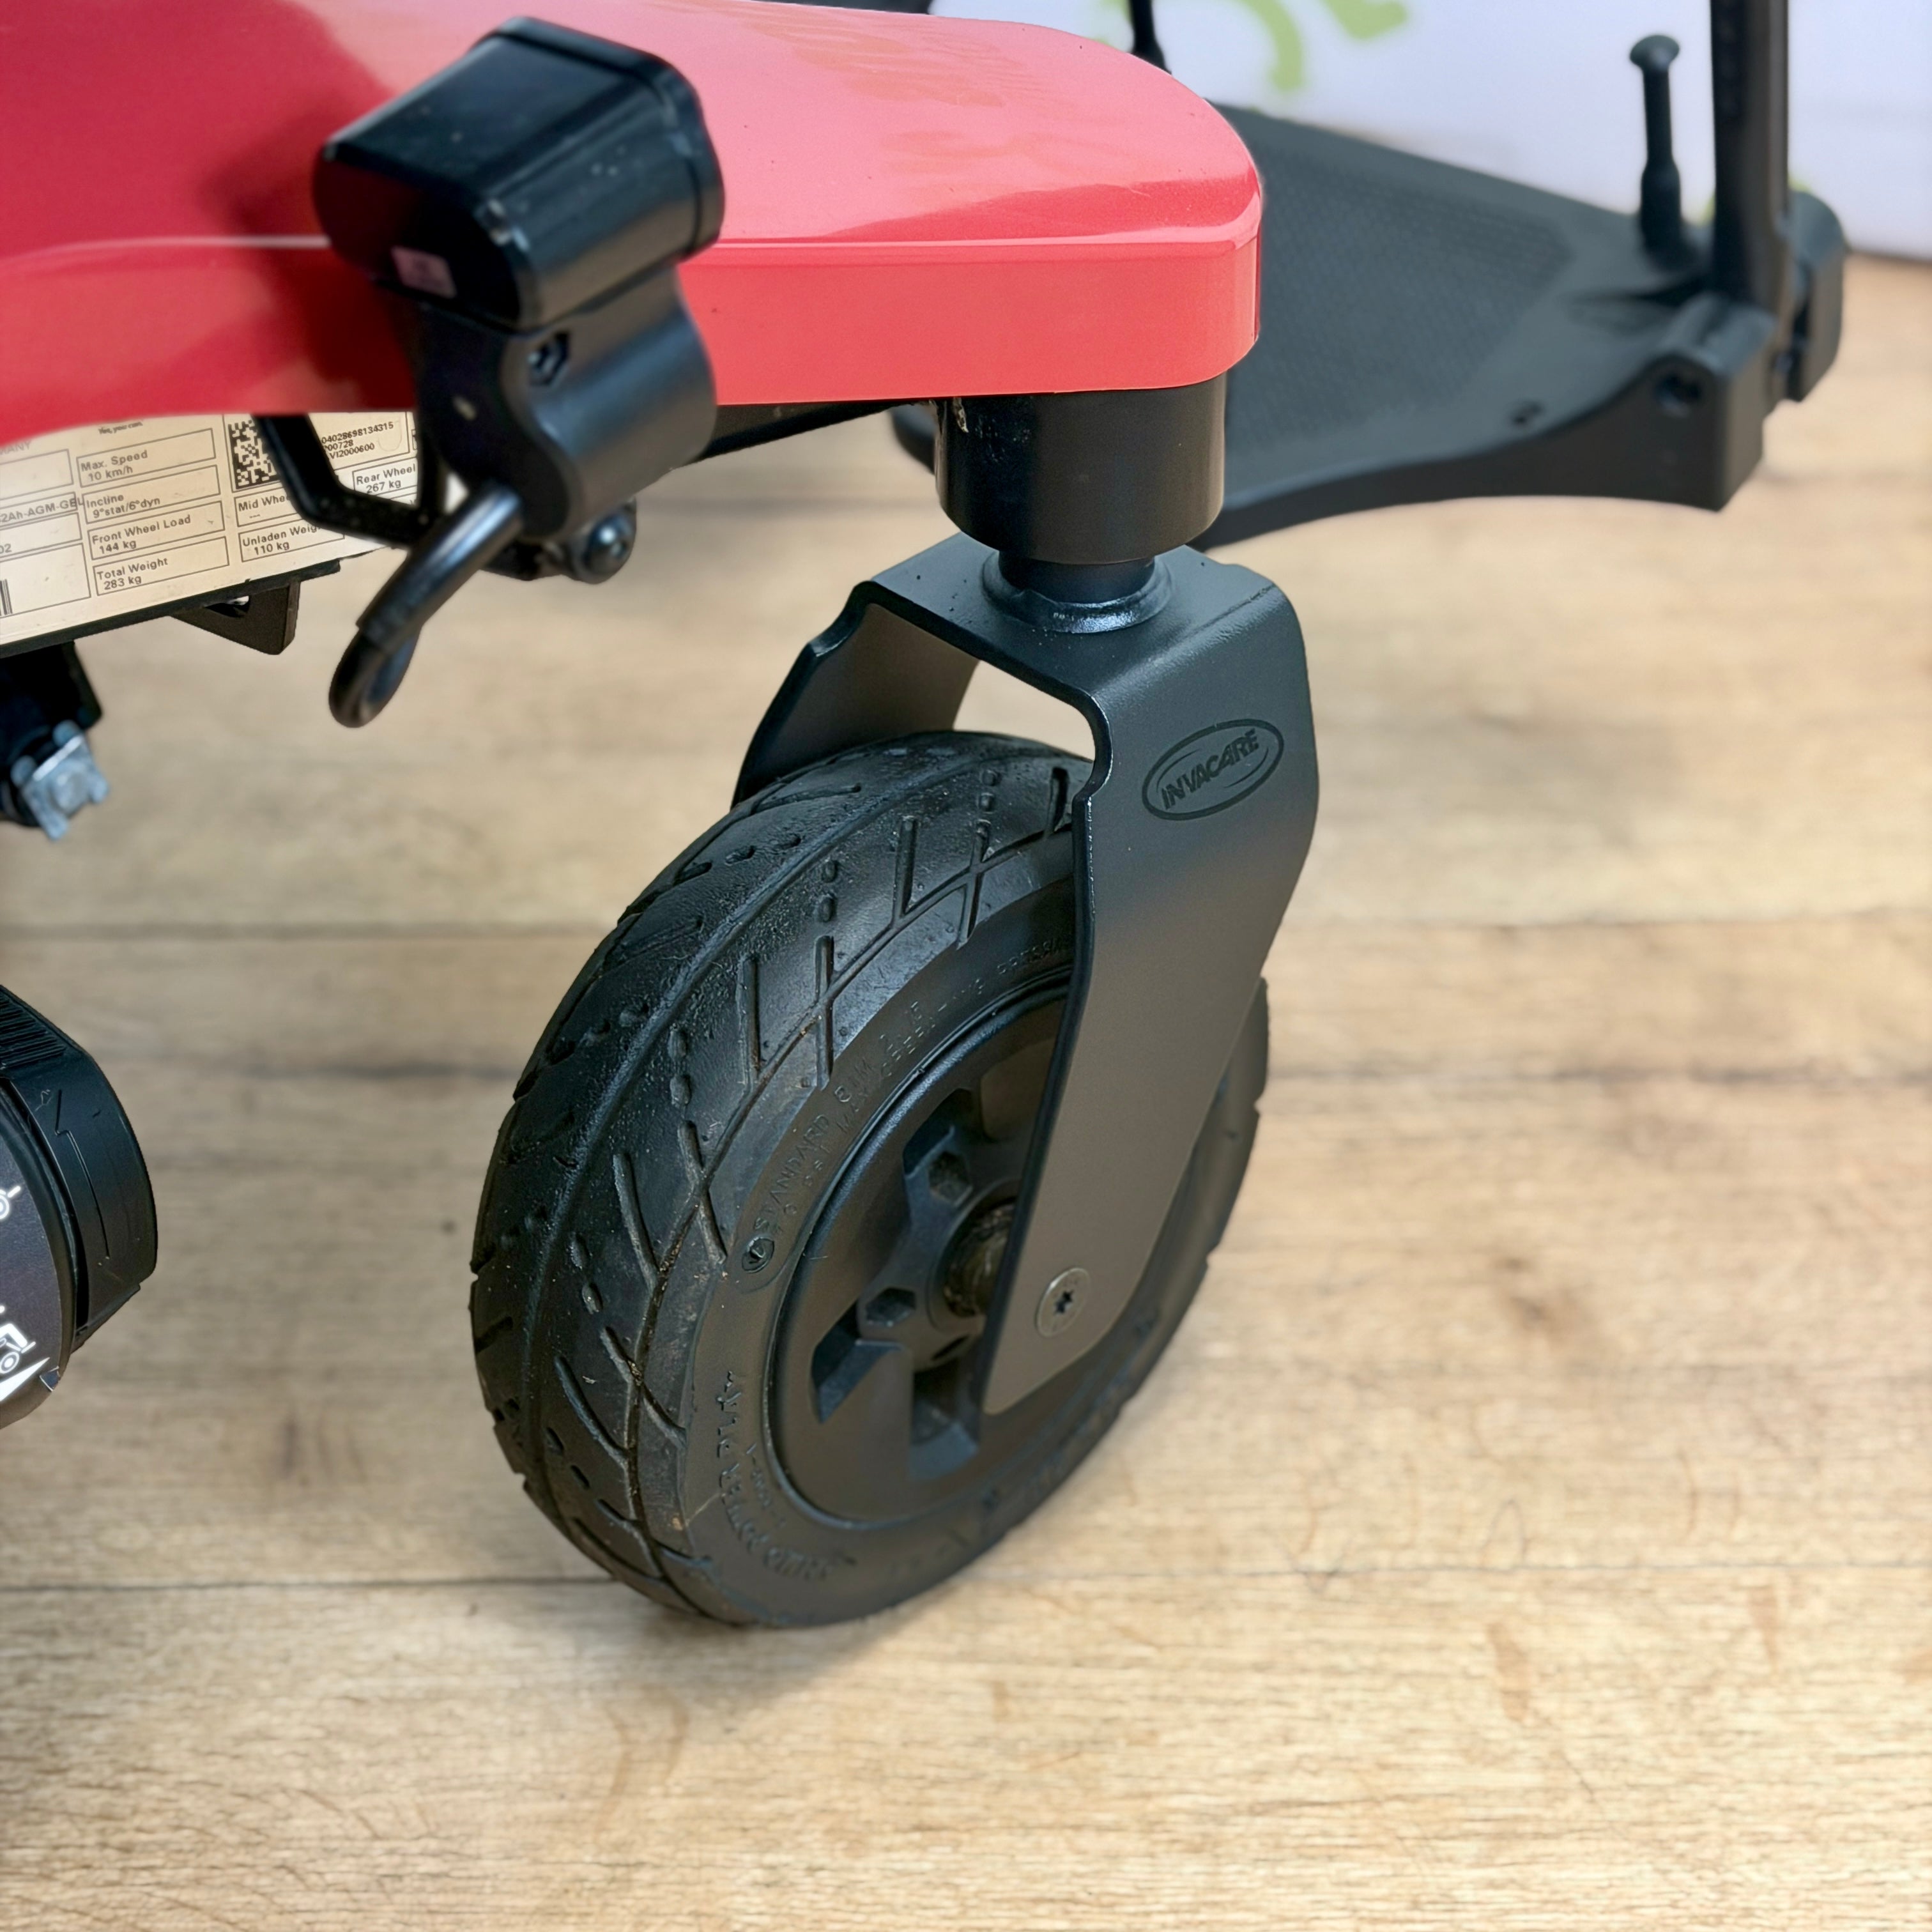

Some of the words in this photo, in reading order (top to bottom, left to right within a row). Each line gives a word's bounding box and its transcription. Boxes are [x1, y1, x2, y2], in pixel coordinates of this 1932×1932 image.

[81, 461, 107, 471] Max.
[111, 450, 148, 466] Speed
[88, 471, 102, 481] 10
[105, 466, 133, 479] km/h
[356, 473, 380, 485] Rear
[383, 463, 416, 479] Wheel
[366, 482, 385, 493] 267
[388, 480, 401, 489] kg
[86, 494, 124, 508] Incline
[238, 499, 259, 512] Mid
[261, 495, 288, 506] Whe
[0, 497, 84, 523] 2Ah-AGM-GEL
[92, 530, 121, 545] Front
[125, 523, 160, 537] Wheel
[164, 515, 191, 529] Load
[243, 531, 287, 546] Unladen
[100, 544, 119, 555] 144
[123, 540, 137, 549] kg
[254, 543, 273, 555] 110
[277, 541, 290, 551] kg
[96, 566, 125, 581] Total
[128, 557, 168, 574] Weight
[103, 579, 125, 590] 283
[128, 575, 142, 585] kg
[1161, 728, 1259, 809] INVACARE
[753, 1114, 830, 1232] STANDARD
